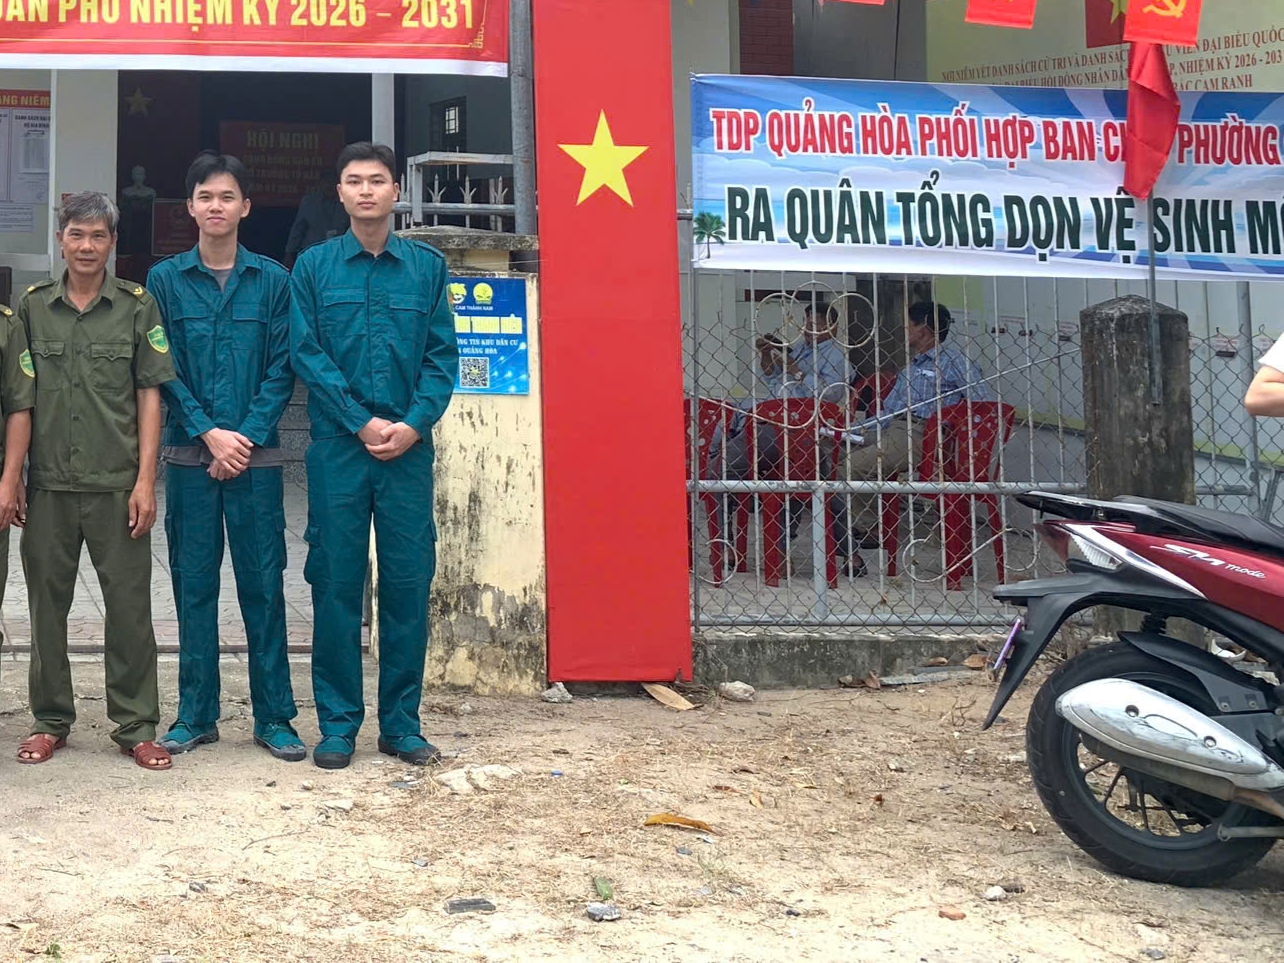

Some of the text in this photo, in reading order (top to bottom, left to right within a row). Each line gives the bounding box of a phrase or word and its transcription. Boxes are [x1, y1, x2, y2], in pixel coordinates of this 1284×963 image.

[1081, 51, 1107, 67] DANH
[1202, 37, 1222, 55] ĐẠI
[1234, 52, 1257, 69] 2026
[1221, 73, 1253, 90] RANH
[711, 110, 760, 152] TDP
[767, 98, 854, 158] QUẢNG
[860, 103, 914, 156] HÒA
[917, 102, 979, 159] PHỐI
[983, 115, 1036, 169] HỢP
[1043, 120, 1096, 161] BAN
[1177, 114, 1281, 166] PHƯỜNG
[726, 186, 776, 243] RA
[786, 177, 887, 250] QUÂN
[895, 169, 995, 249] TỔNG
[1003, 194, 1082, 262] DỌN
[1089, 186, 1136, 264] VỆ
[1152, 197, 1237, 254] SINH
[1224, 563, 1266, 579] mode
